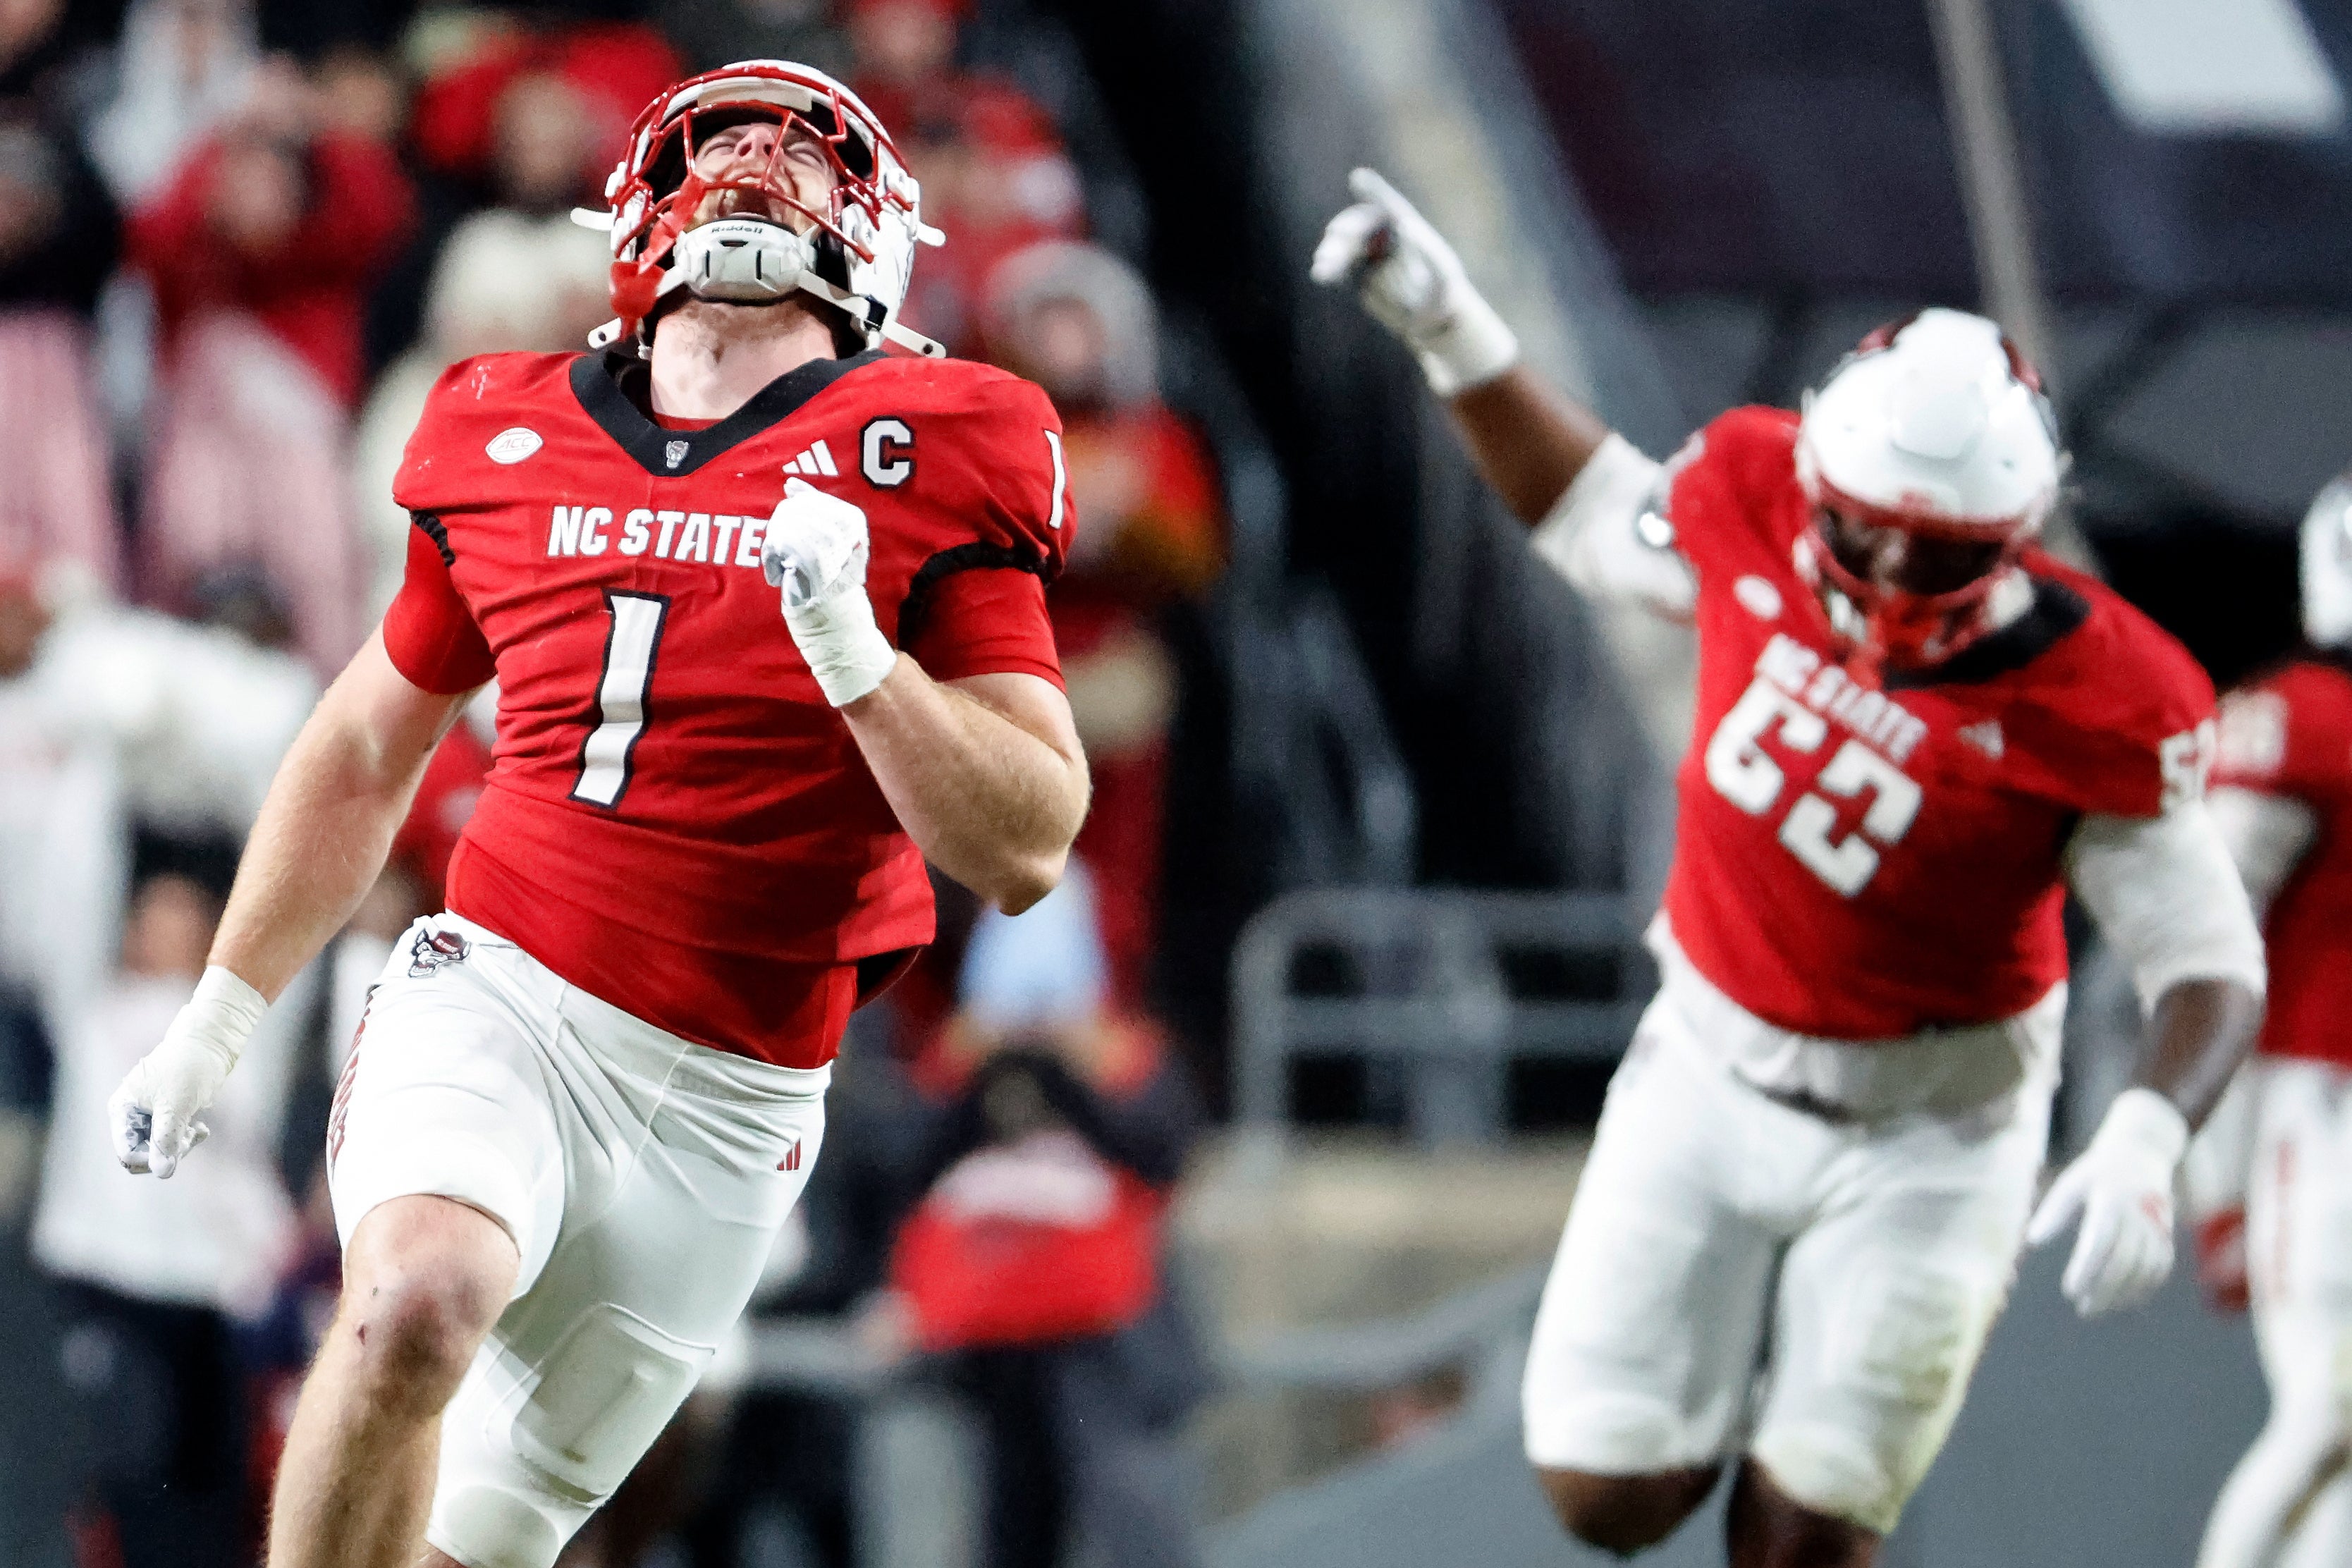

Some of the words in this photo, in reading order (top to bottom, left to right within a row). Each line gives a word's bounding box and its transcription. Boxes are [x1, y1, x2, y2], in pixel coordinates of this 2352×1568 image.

[496, 436, 533, 449] ACC
[860, 417, 916, 489] C
[546, 506, 614, 557] NC
[618, 508, 769, 568] STATE
[567, 588, 671, 811] 1
